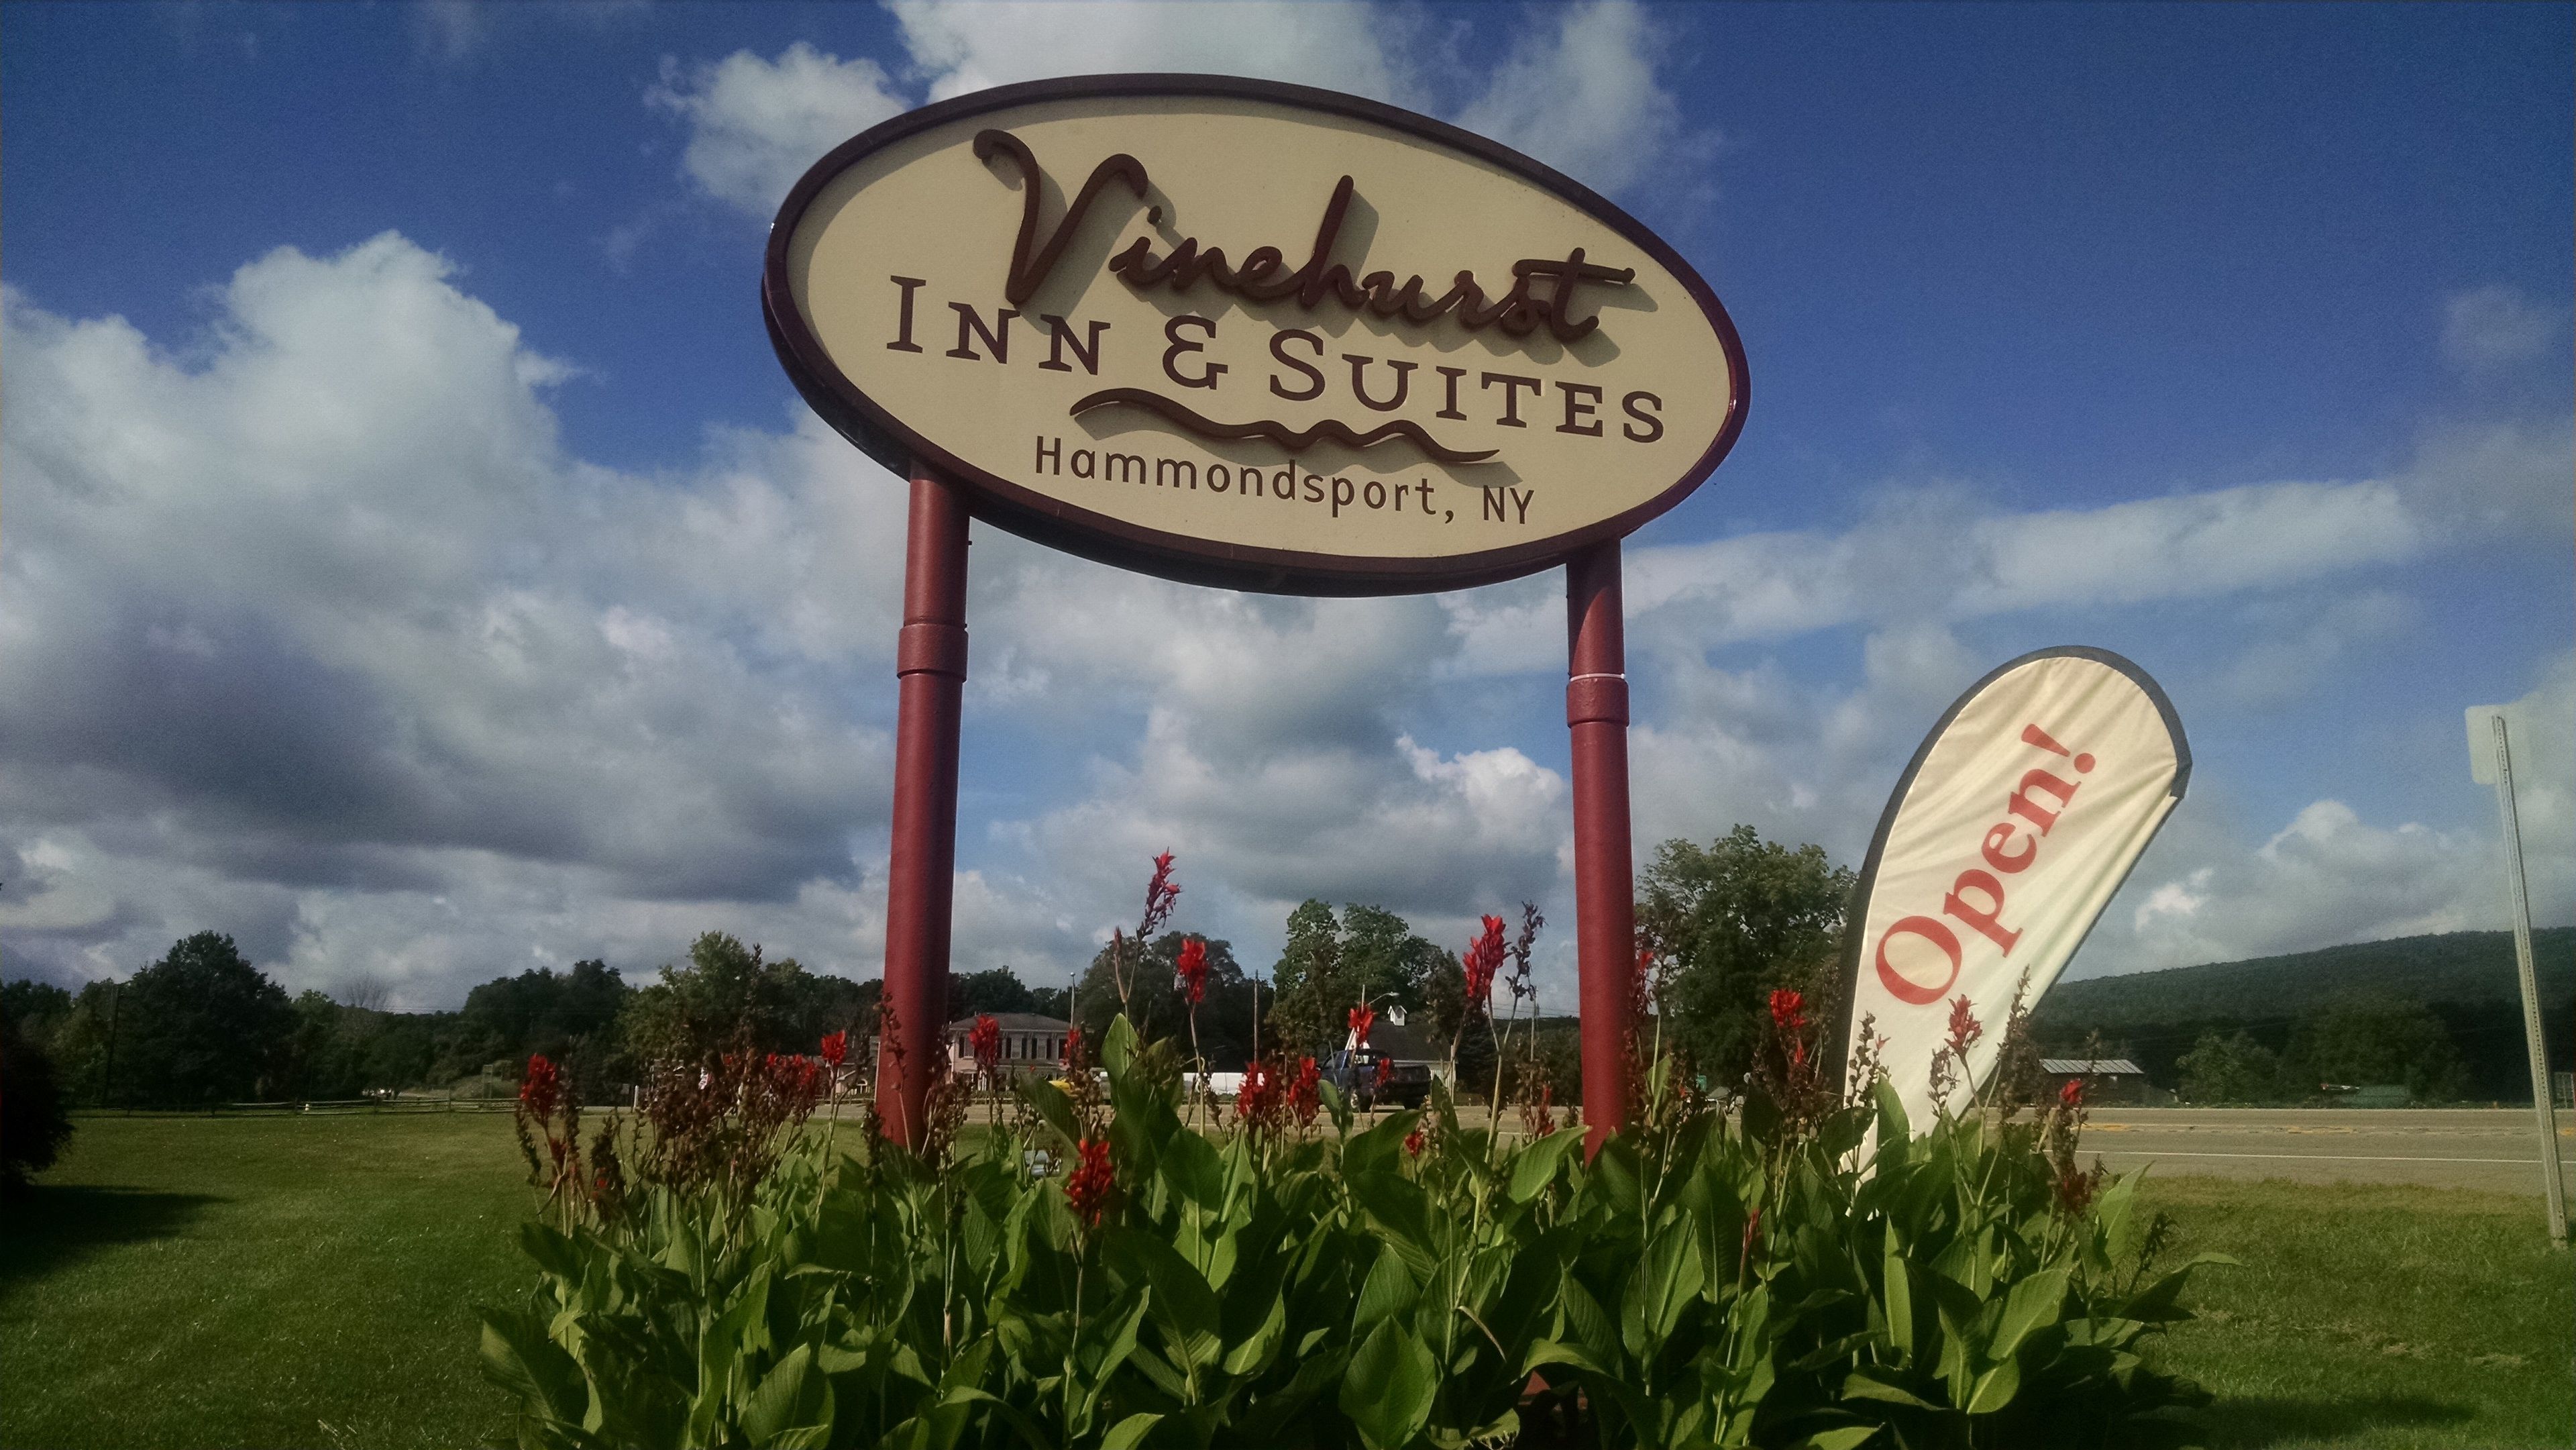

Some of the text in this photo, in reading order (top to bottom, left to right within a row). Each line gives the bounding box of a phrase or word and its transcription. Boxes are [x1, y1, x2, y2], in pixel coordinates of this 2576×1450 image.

[973, 129, 1635, 340] Vinehurst
[886, 275, 1665, 443] INN & SUITES
[1035, 435, 1534, 524] Hammondsport, NY
[1876, 724, 2096, 1004] Open!
